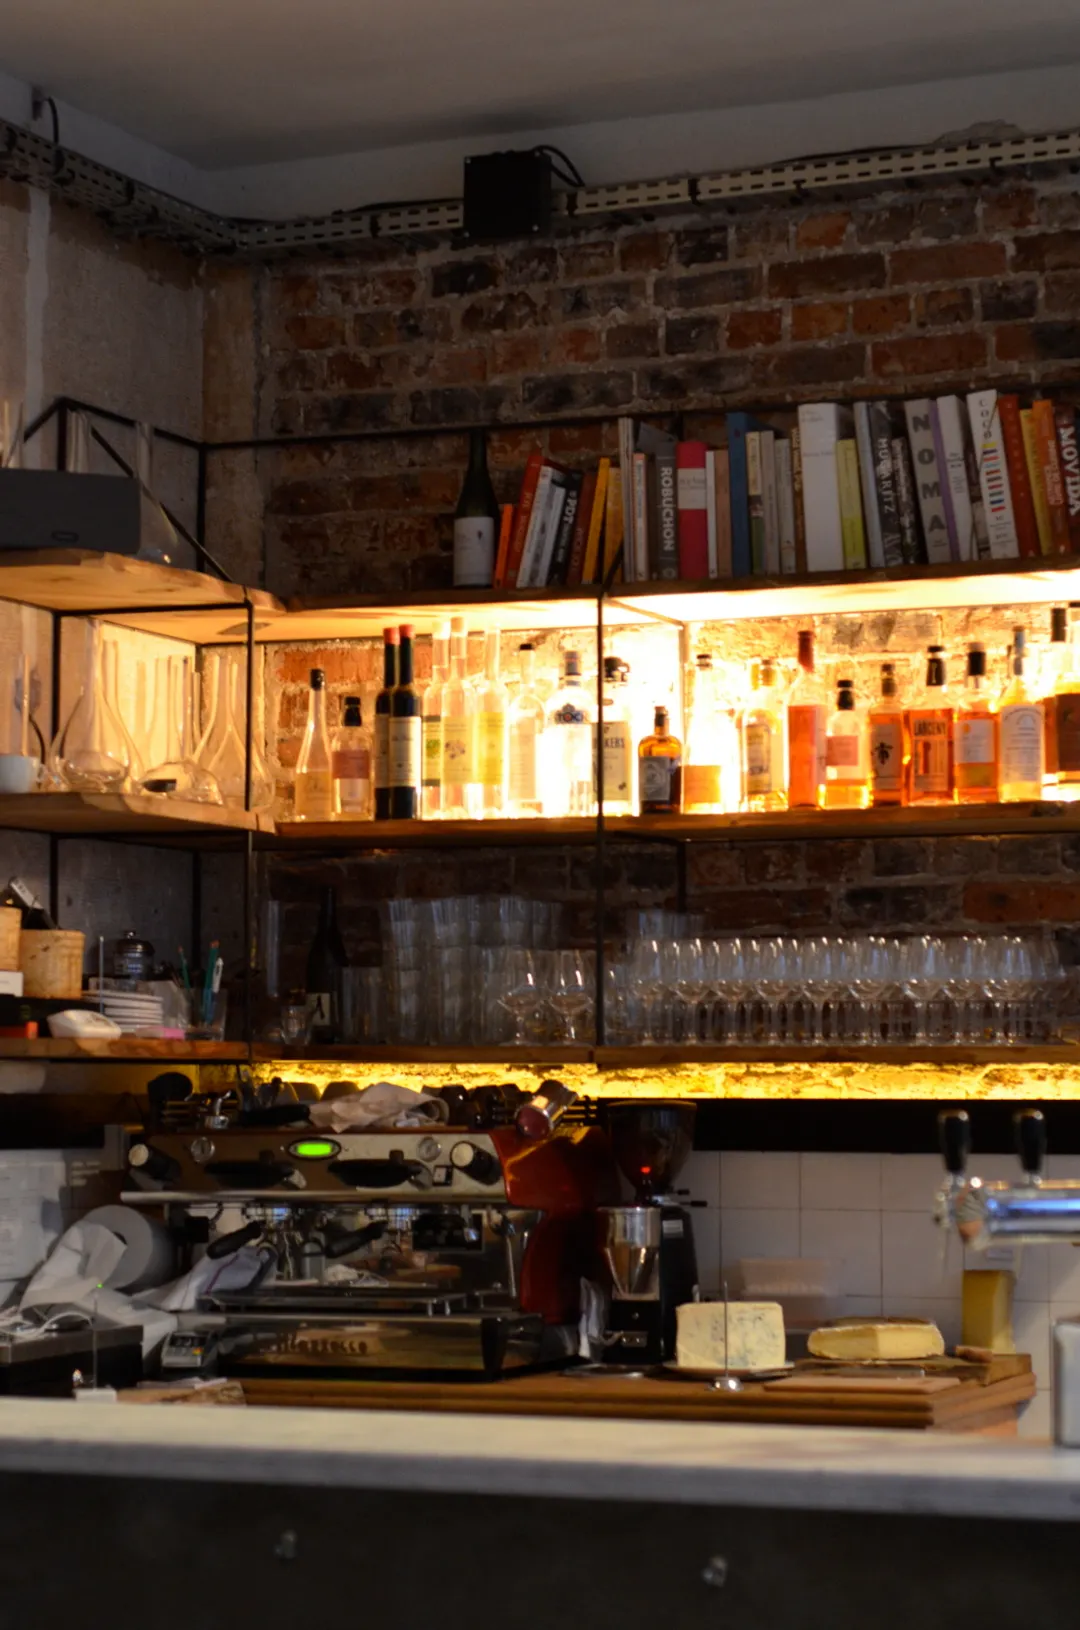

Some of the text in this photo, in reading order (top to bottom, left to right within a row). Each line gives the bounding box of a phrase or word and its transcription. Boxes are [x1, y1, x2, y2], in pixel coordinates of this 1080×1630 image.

[563, 497, 579, 525] PDT
[660, 466, 675, 551] ROBUCHON
[877, 437, 896, 514] MUGARITZ
[912, 414, 946, 532] NOMA
[1059, 426, 1080, 516] MOVIDA
